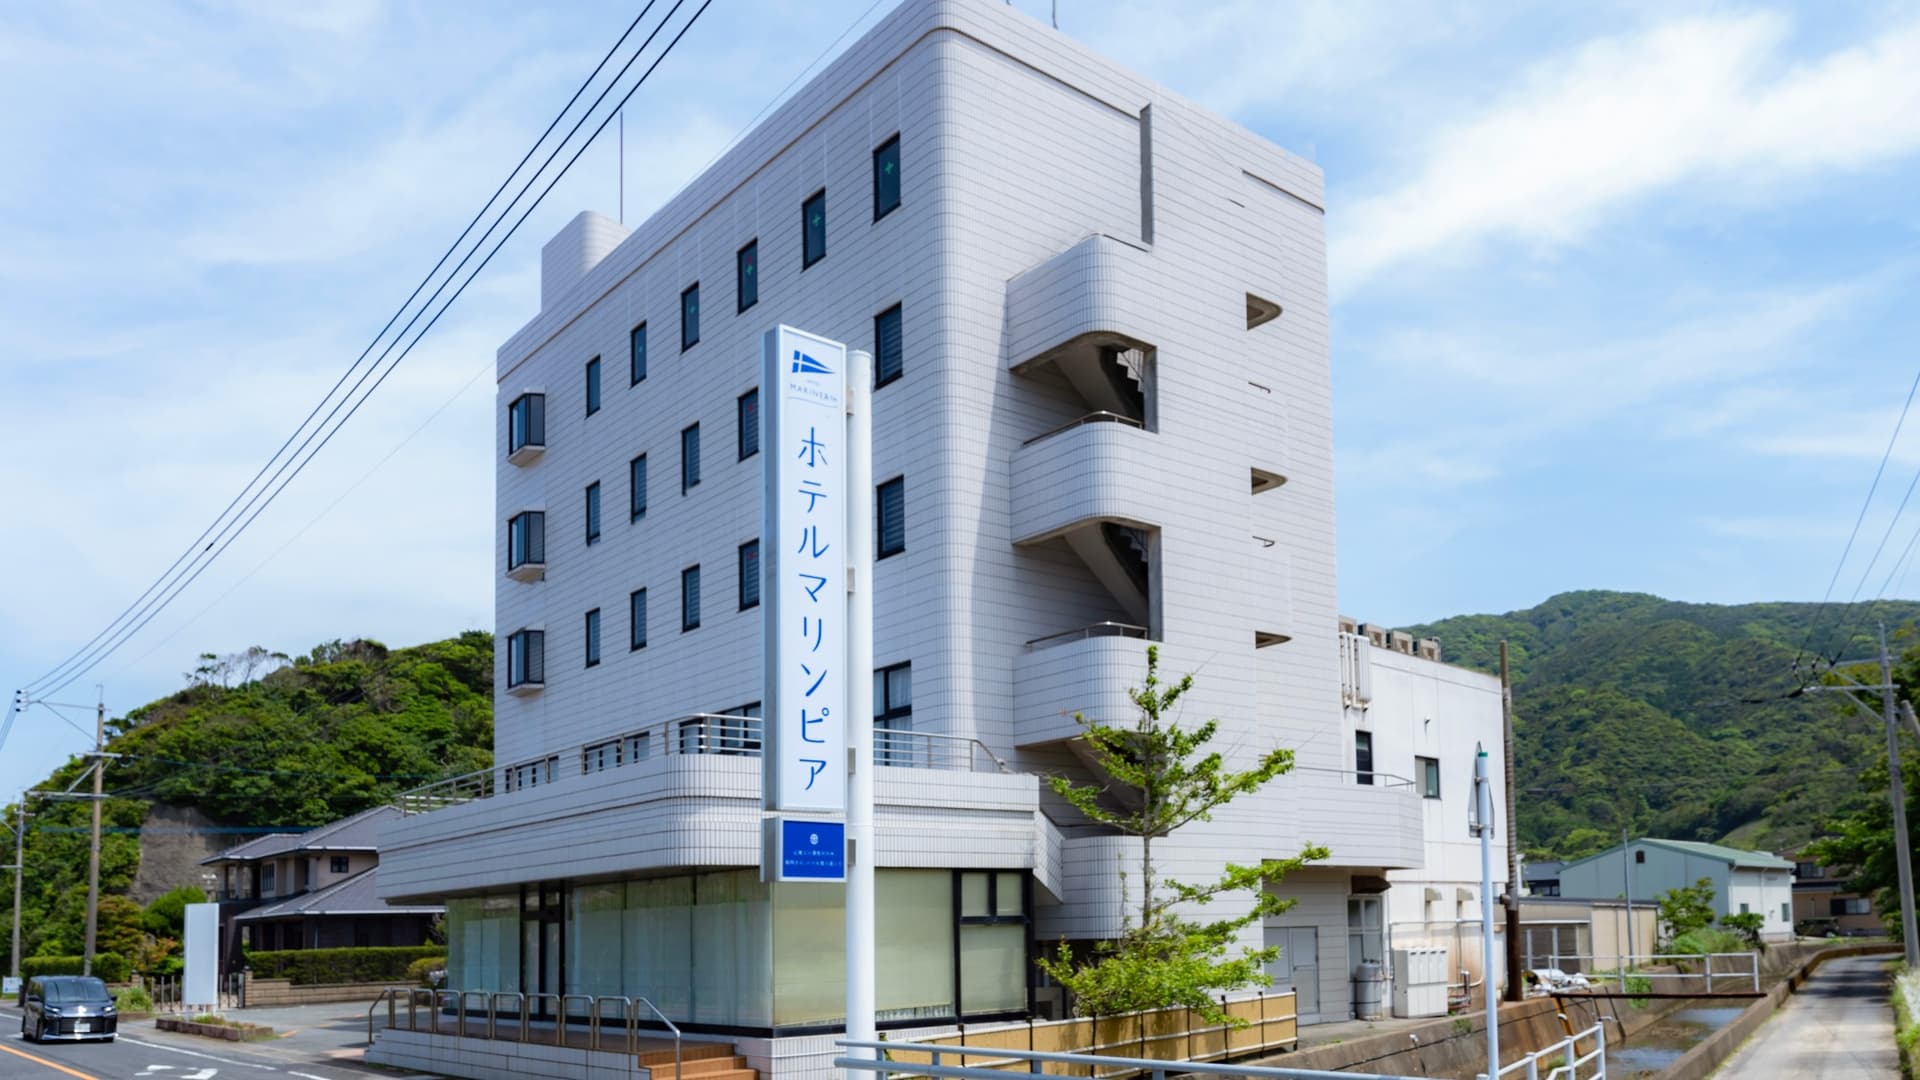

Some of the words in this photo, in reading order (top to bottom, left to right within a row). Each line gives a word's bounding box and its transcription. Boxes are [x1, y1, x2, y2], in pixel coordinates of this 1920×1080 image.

[797, 426, 830, 790] ホテルマリンピア
